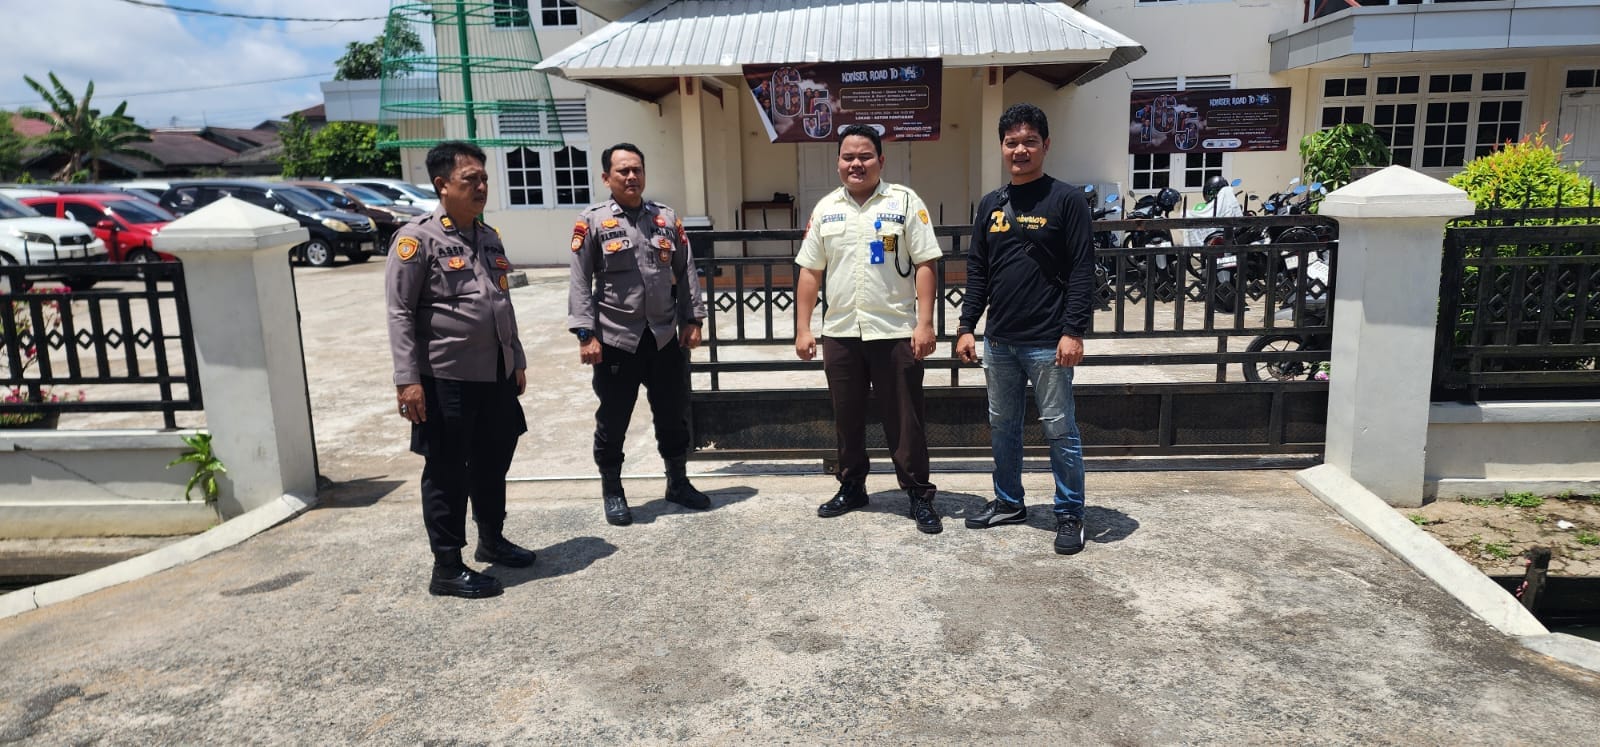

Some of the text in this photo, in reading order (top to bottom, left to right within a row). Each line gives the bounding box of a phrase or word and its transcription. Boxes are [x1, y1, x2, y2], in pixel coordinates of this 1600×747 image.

[841, 71, 869, 83] KONSER
[869, 69, 888, 81] ROAD
[889, 67, 898, 80] TO
[1231, 96, 1247, 106] ROAD
[1248, 95, 1255, 104] TO
